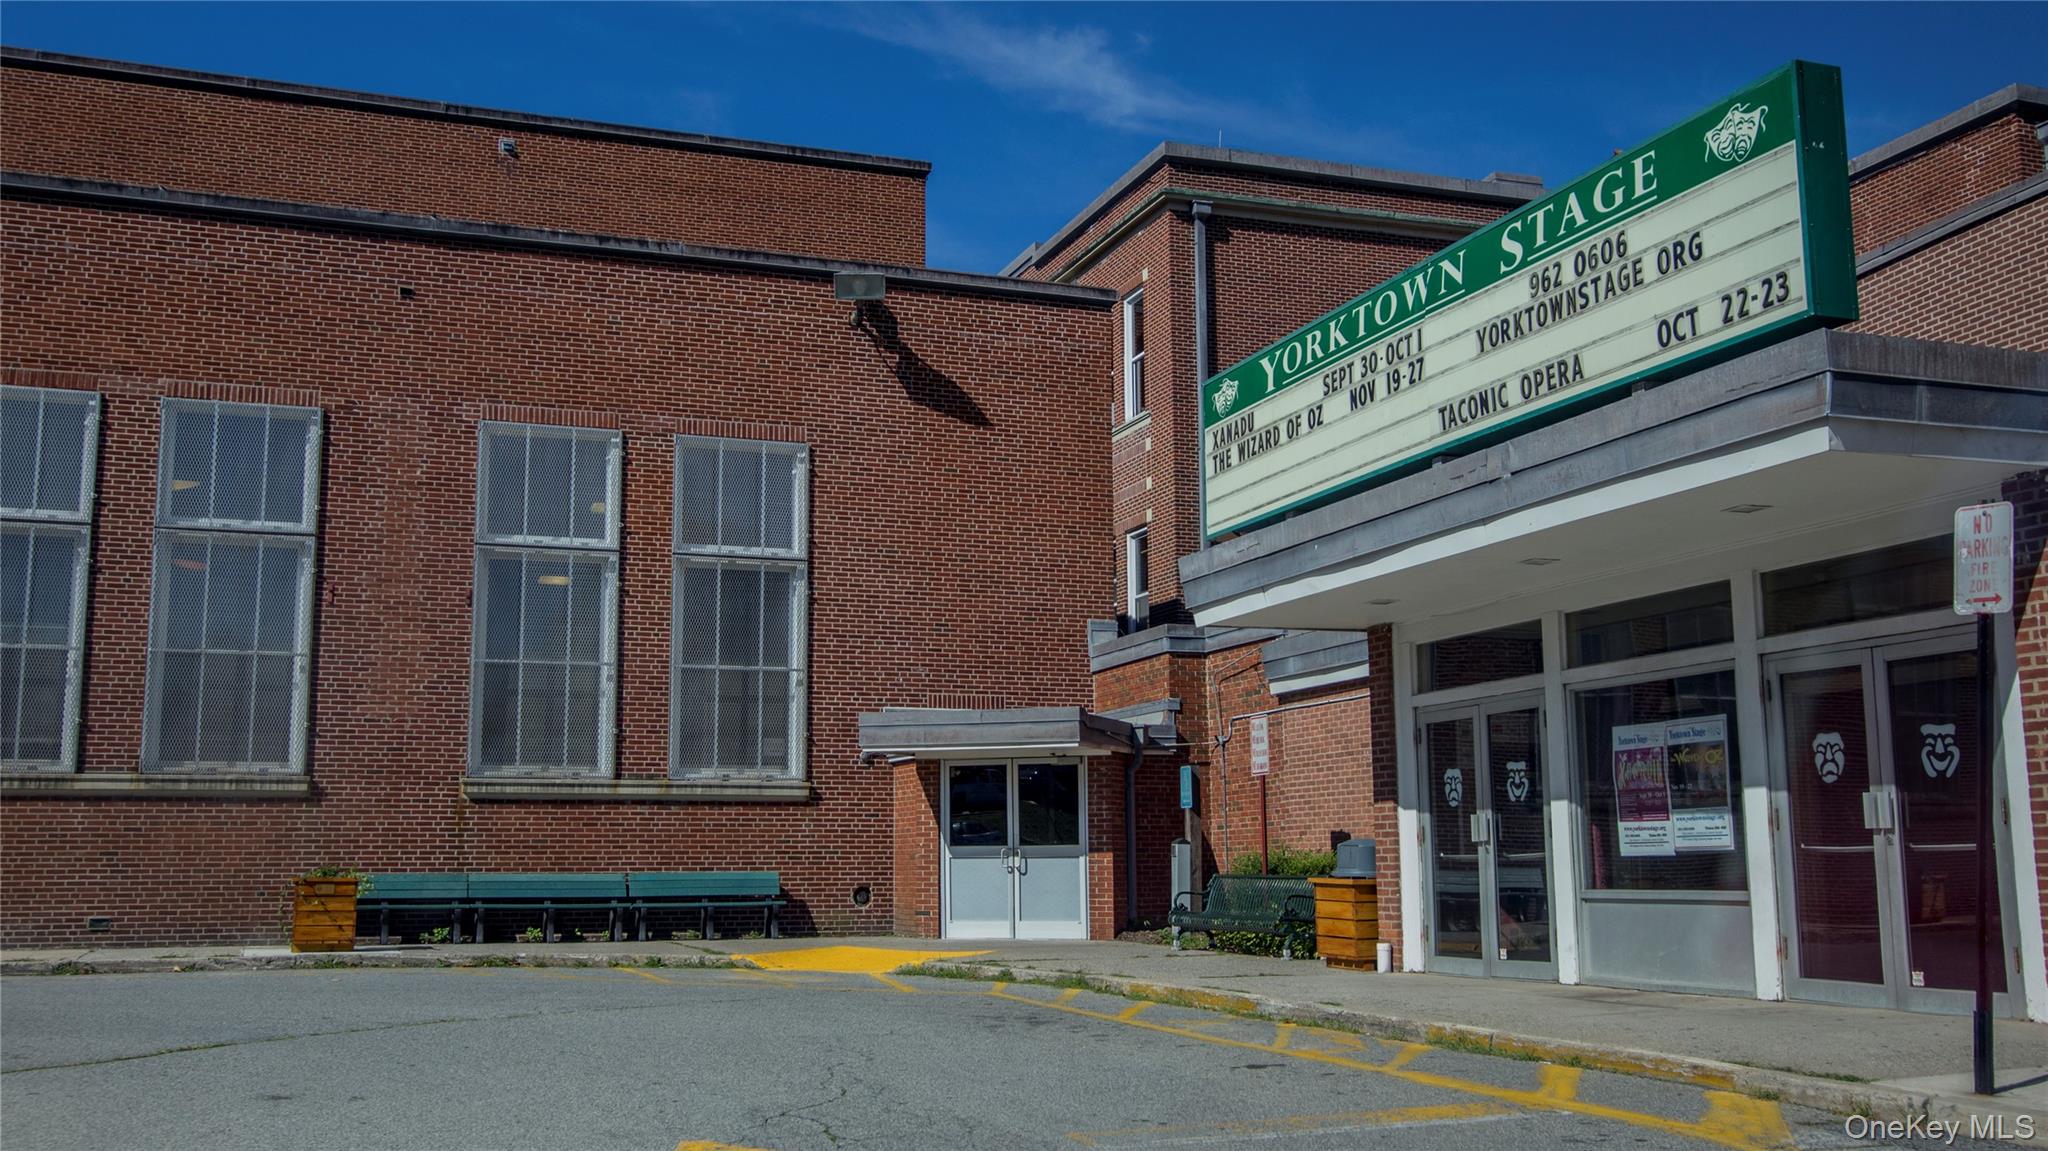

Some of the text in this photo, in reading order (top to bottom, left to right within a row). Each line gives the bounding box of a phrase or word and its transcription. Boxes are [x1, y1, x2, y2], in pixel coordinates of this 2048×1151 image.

[1258, 150, 1657, 394] YORKTOWN STAGE
[1475, 231, 1703, 353] YORKTOWNSTAGE ORG
[1529, 230, 1628, 298] 962 0606
[1656, 270, 1791, 348] OCT 22-23
[1322, 361, 1355, 397] SEPT
[1350, 356, 1425, 411] NOV 19-27
[1437, 354, 1585, 432] TACONIC OPERA
[1212, 411, 1255, 450] XANADU
[1212, 404, 1324, 475] THE WIZARD OF OZ
[1959, 536, 2009, 559] PARKING
[1974, 514, 1992, 534] NO
[1971, 562, 1996, 576] FIRE
